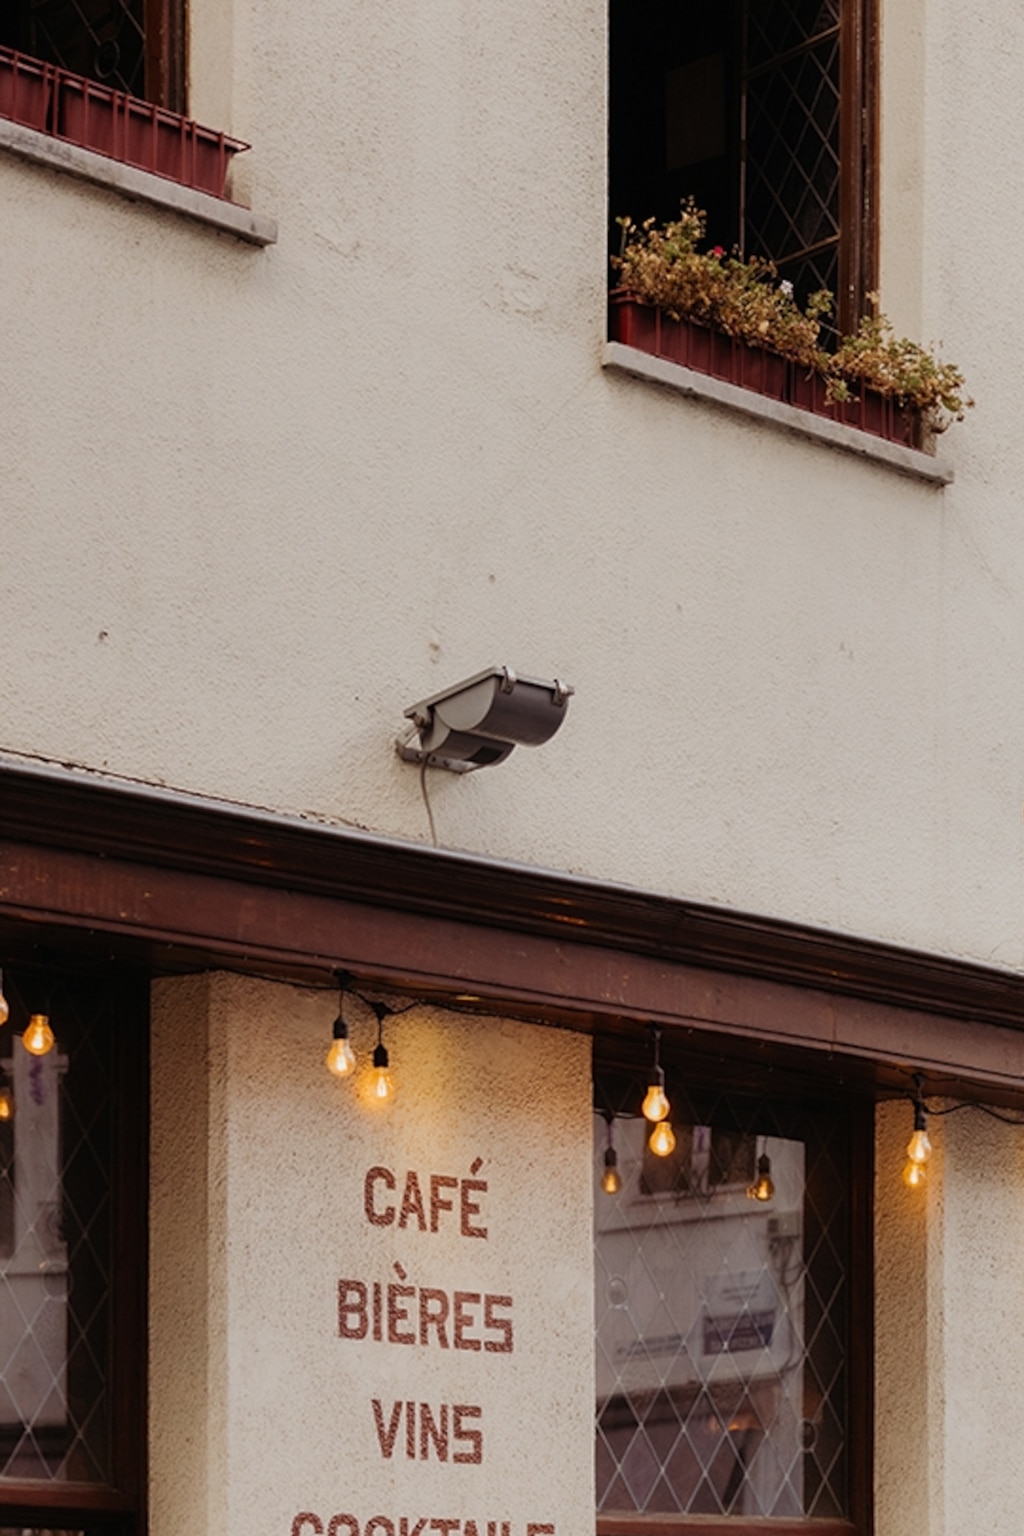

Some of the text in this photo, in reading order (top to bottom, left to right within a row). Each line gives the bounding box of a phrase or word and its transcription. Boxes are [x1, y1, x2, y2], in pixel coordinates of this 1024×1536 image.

[363, 1155, 489, 1241] CAFÉ
[337, 1260, 514, 1354] BIÈRES
[370, 1398, 484, 1465] VINS
